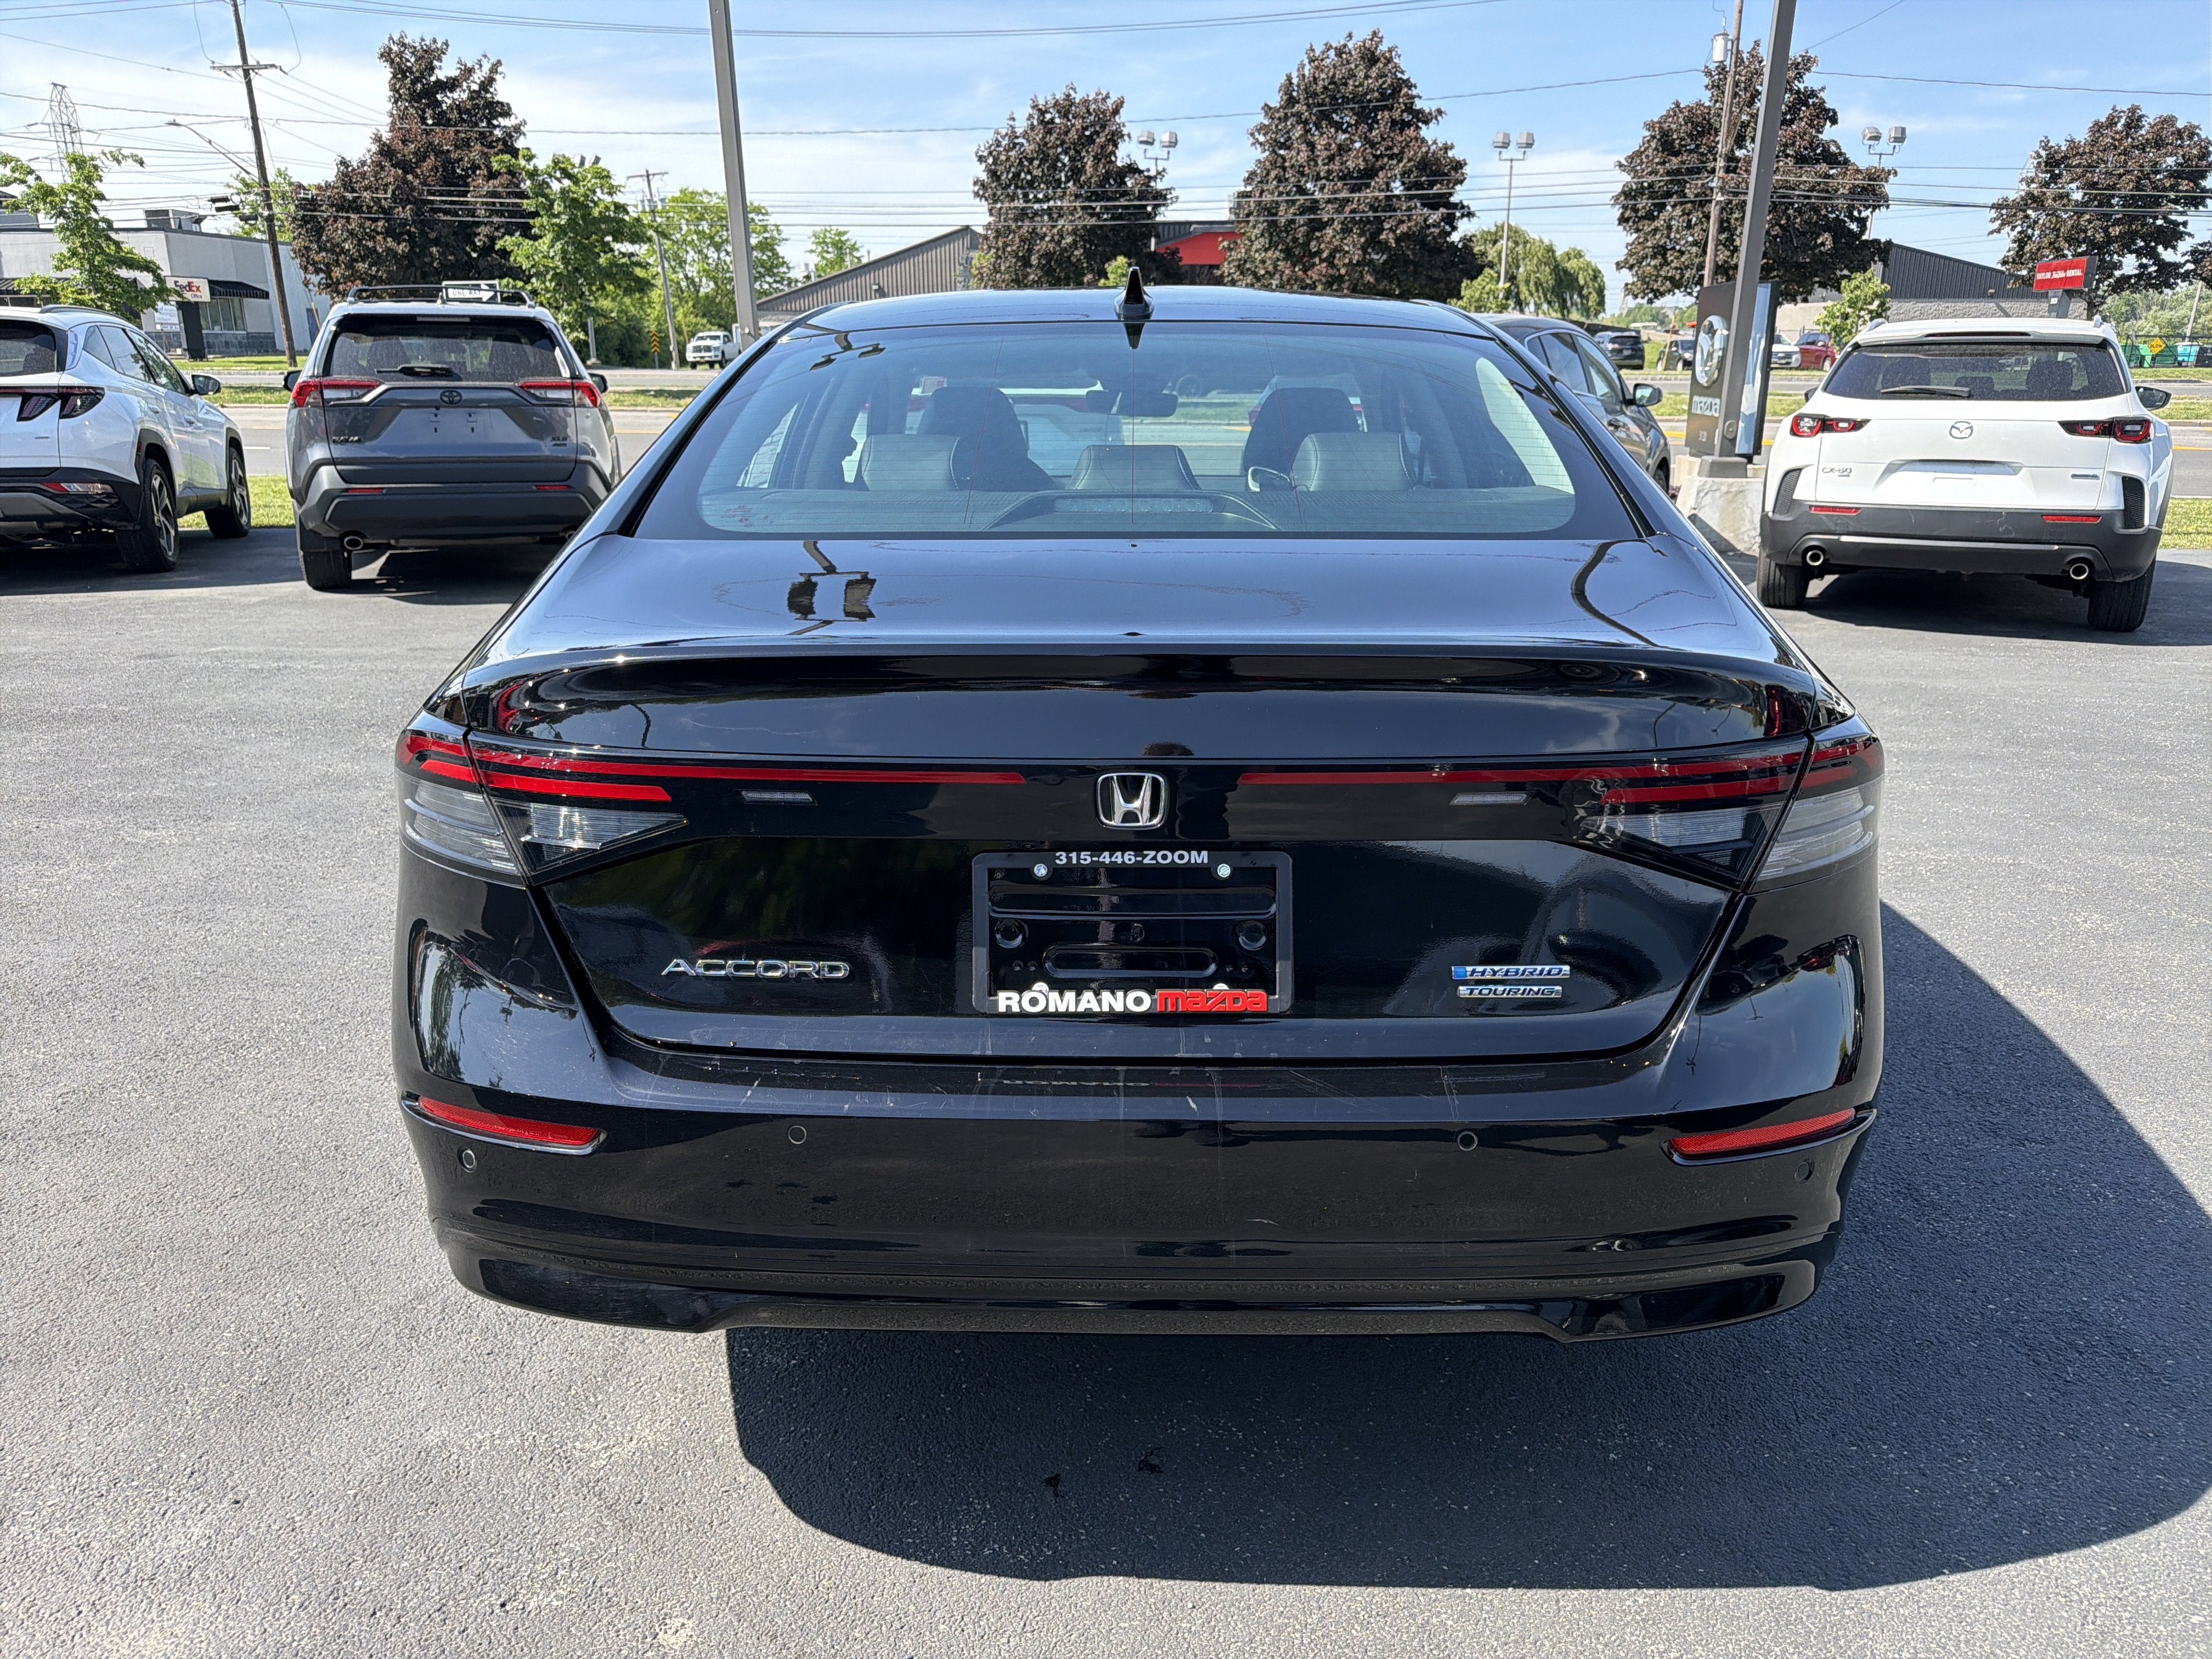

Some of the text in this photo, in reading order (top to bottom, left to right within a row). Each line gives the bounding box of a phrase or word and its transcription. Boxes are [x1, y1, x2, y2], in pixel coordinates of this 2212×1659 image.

[2036, 271, 2051, 280] TAYLOR
[174, 280, 201, 294] FedEx
[1691, 396, 1720, 417] mazda
[1054, 850, 1209, 865] 315-446-ZOOM
[661, 958, 850, 979] ACCORD
[1470, 967, 1564, 977] HYBRID
[1466, 987, 1556, 996] TOURING
[997, 990, 1268, 1013] ROMANO mazda
